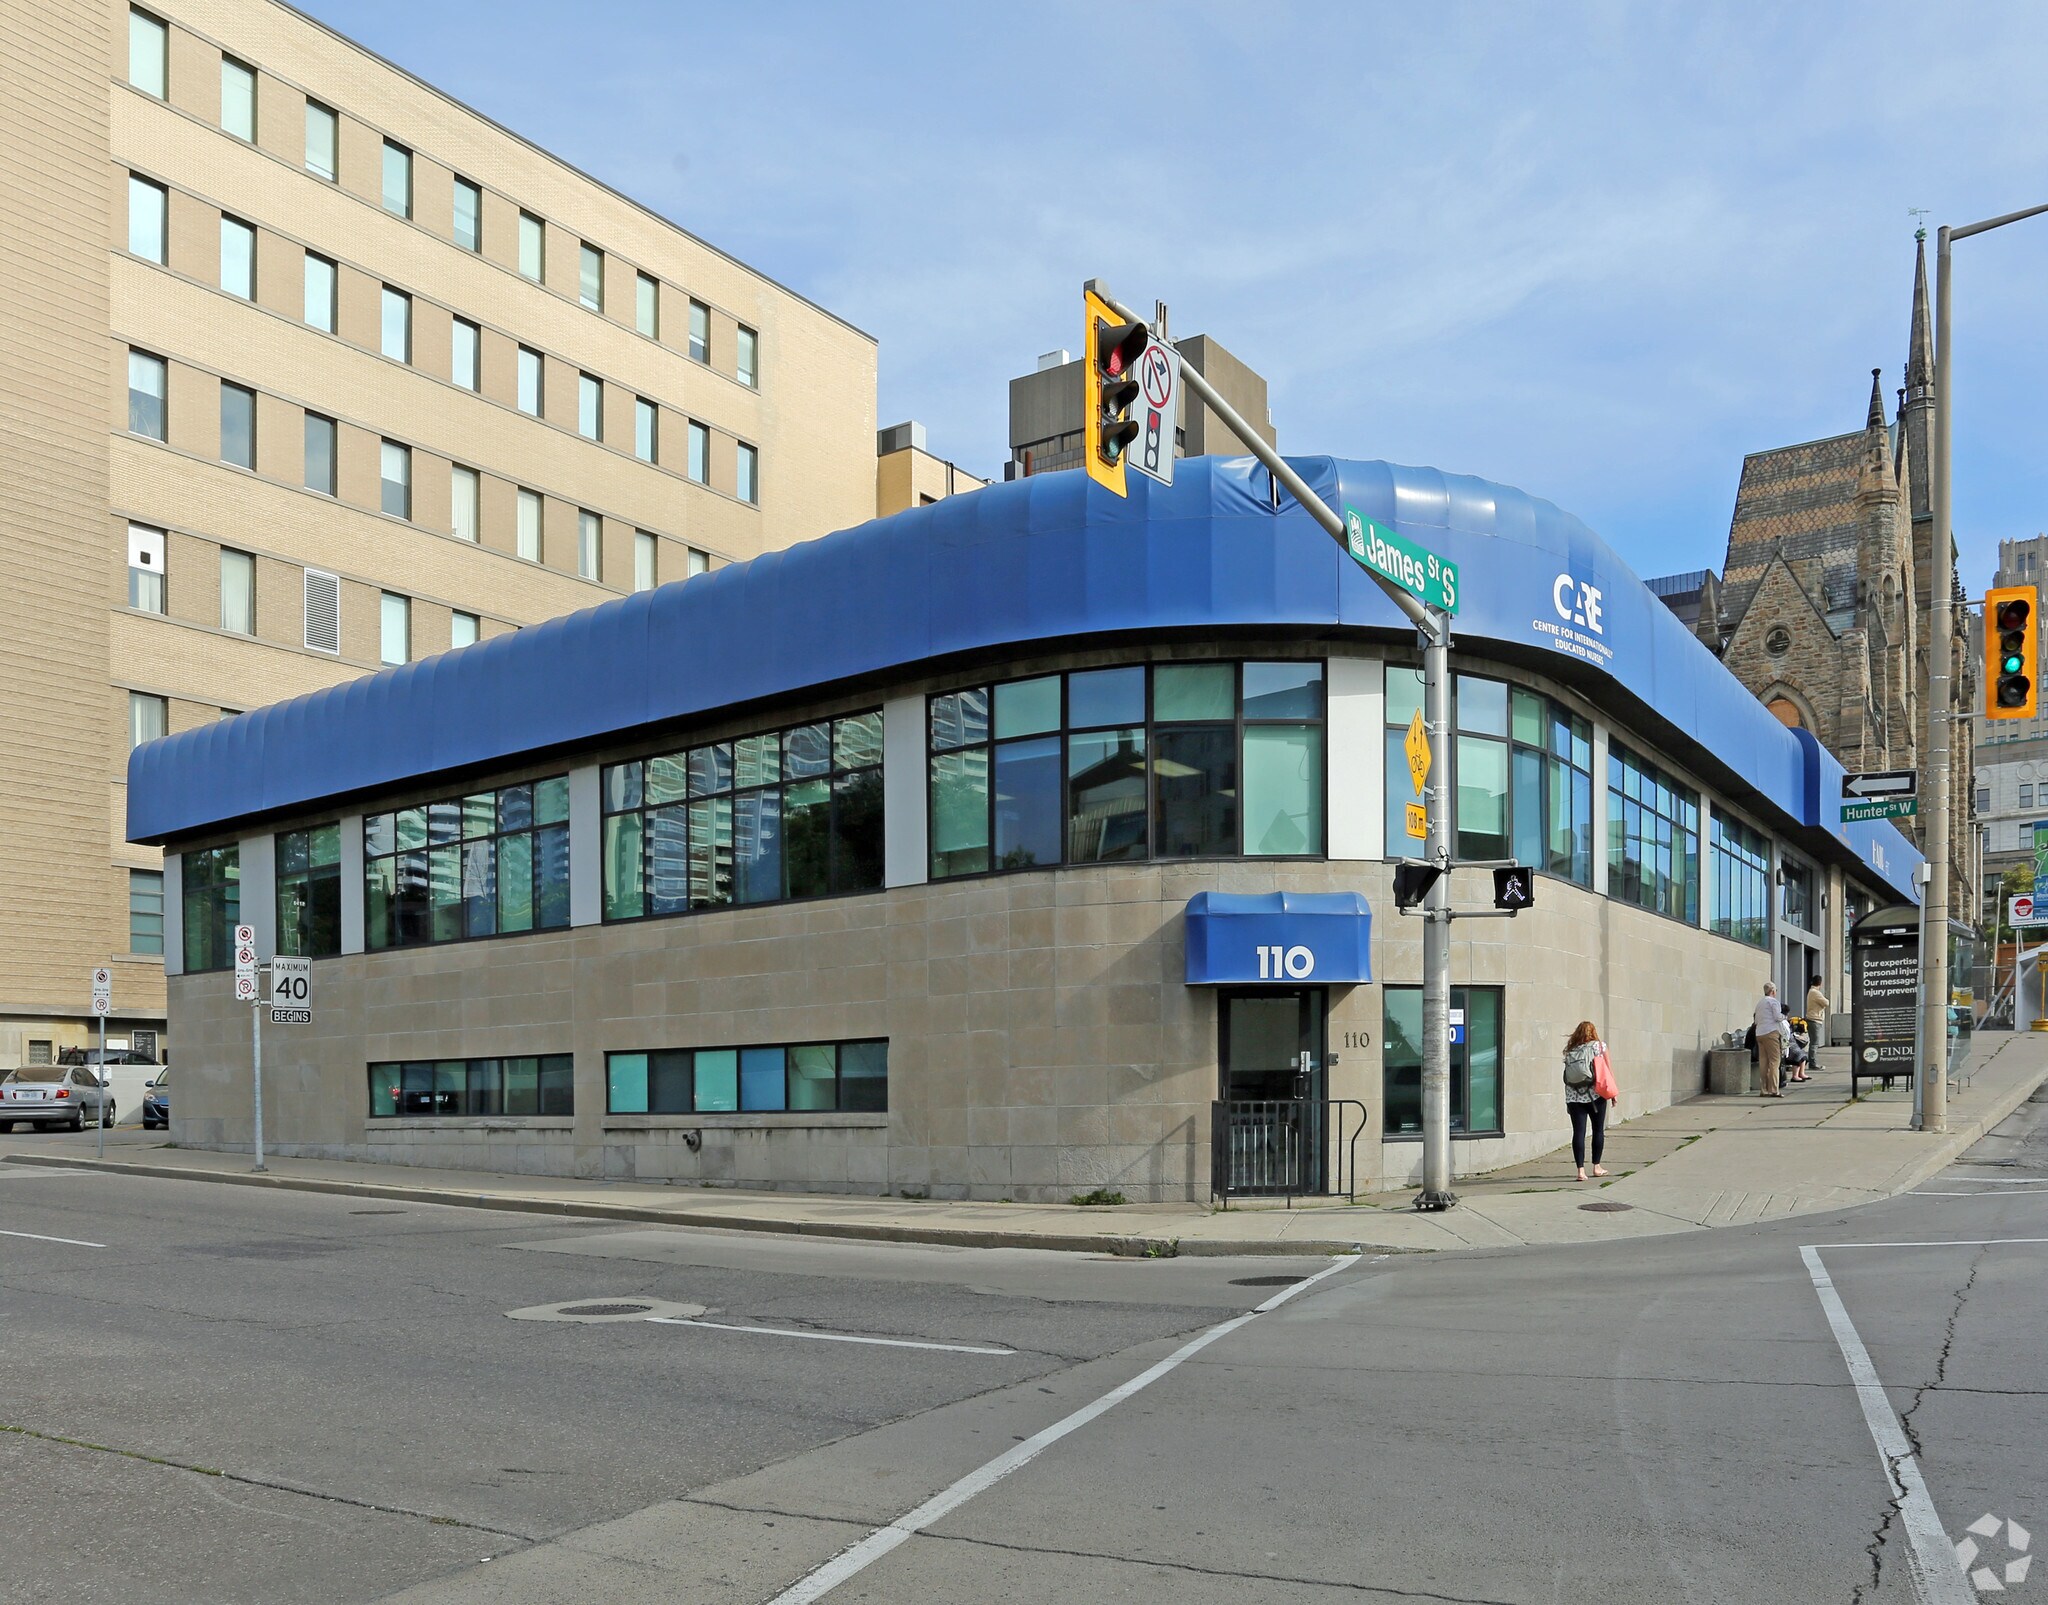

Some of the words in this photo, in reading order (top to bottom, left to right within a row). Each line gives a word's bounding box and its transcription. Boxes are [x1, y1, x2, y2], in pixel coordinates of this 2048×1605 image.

[1366, 524, 1425, 592] James
[1427, 554, 1440, 581] St
[1442, 566, 1455, 607] S
[1553, 573, 1603, 635] CARE
[1532, 619, 1560, 636] CENTRE
[1560, 627, 1574, 640] FOR
[1574, 631, 1613, 660] INTERNATIONALLY
[1555, 638, 1586, 657] EDUCATED
[1586, 649, 1604, 666] NURSES
[1846, 806, 1888, 820] Hunter
[1889, 803, 1897, 811] St
[1899, 802, 1912, 814] W
[275, 963, 309, 972] MAXIMUM
[1256, 945, 1315, 979] 110
[1863, 960, 1879, 968] Our
[1879, 958, 1918, 967] expertise
[1863, 968, 1898, 979] personal
[1899, 967, 1919, 976] injur
[275, 976, 308, 1000] 40
[1863, 979, 1879, 987] Our
[1879, 977, 1916, 986] message
[1863, 988, 1886, 997] injury
[1887, 986, 1918, 996] prevent
[273, 1011, 309, 1022] BEGINS
[1344, 1031, 1370, 1048] 110
[1880, 1046, 1916, 1056] FINDL
